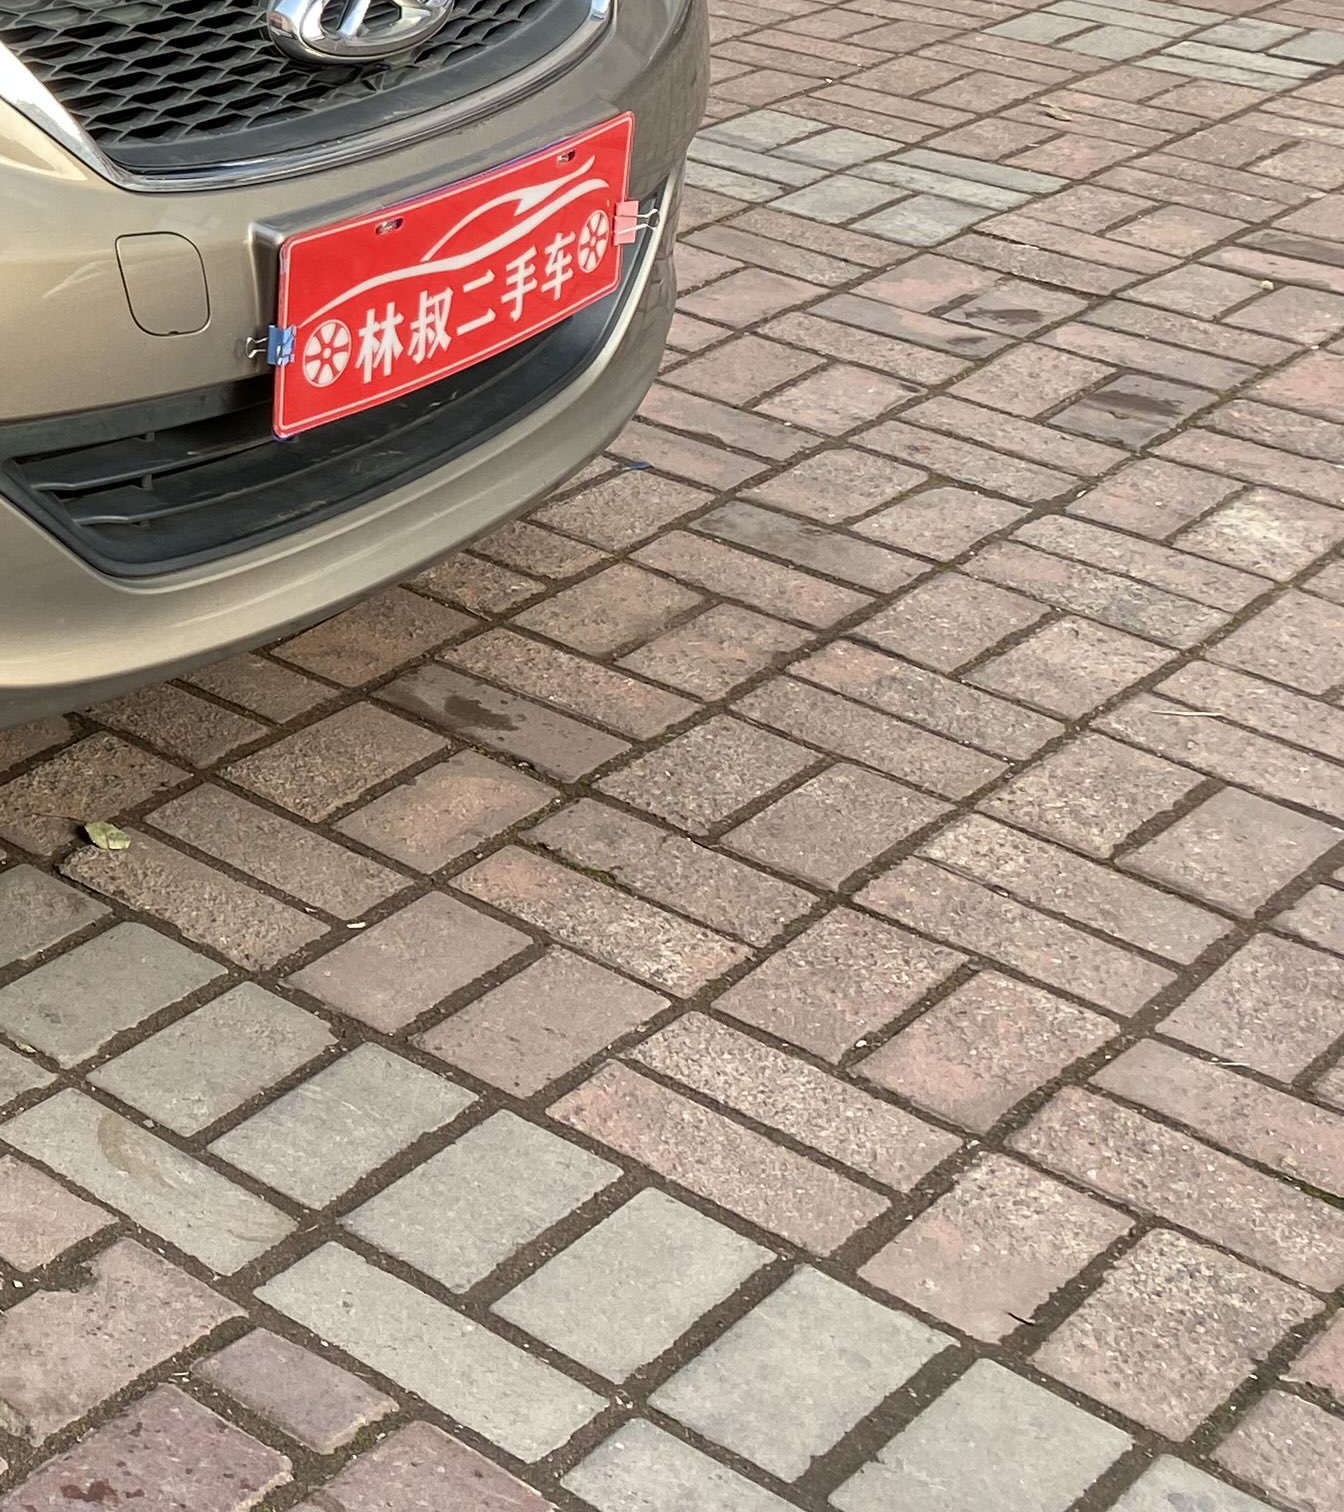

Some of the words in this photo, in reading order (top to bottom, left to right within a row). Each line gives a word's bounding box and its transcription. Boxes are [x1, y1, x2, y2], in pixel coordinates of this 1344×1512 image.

[355, 231, 575, 383] 林叔二手车
